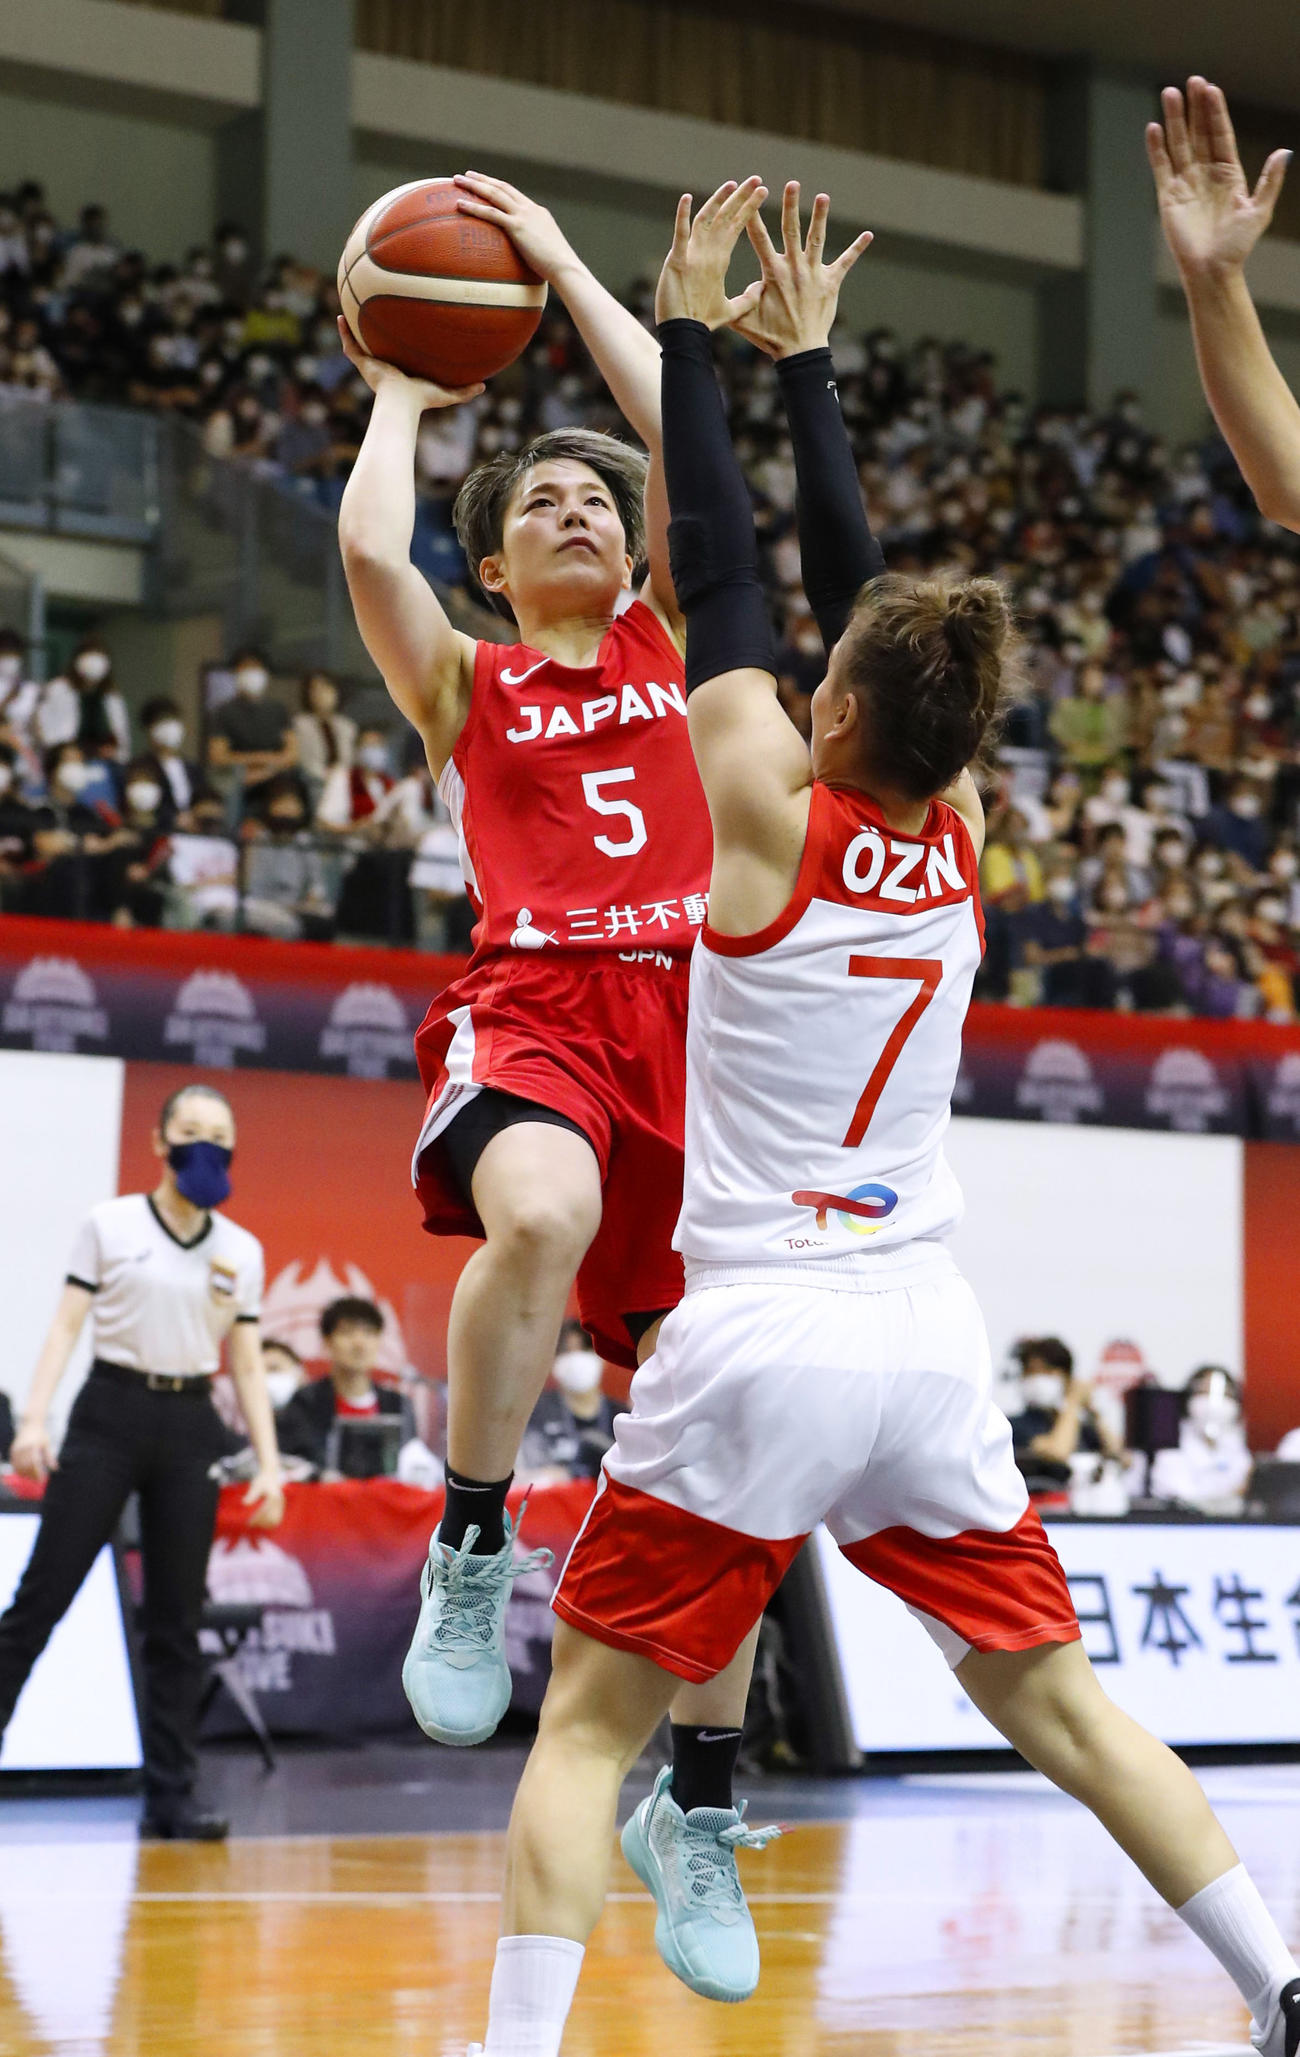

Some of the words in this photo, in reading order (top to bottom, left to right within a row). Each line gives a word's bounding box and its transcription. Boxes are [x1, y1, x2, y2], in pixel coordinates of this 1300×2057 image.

[505, 682, 688, 744] JAPAN
[580, 766, 648, 858] 5
[840, 954, 943, 1148] 7
